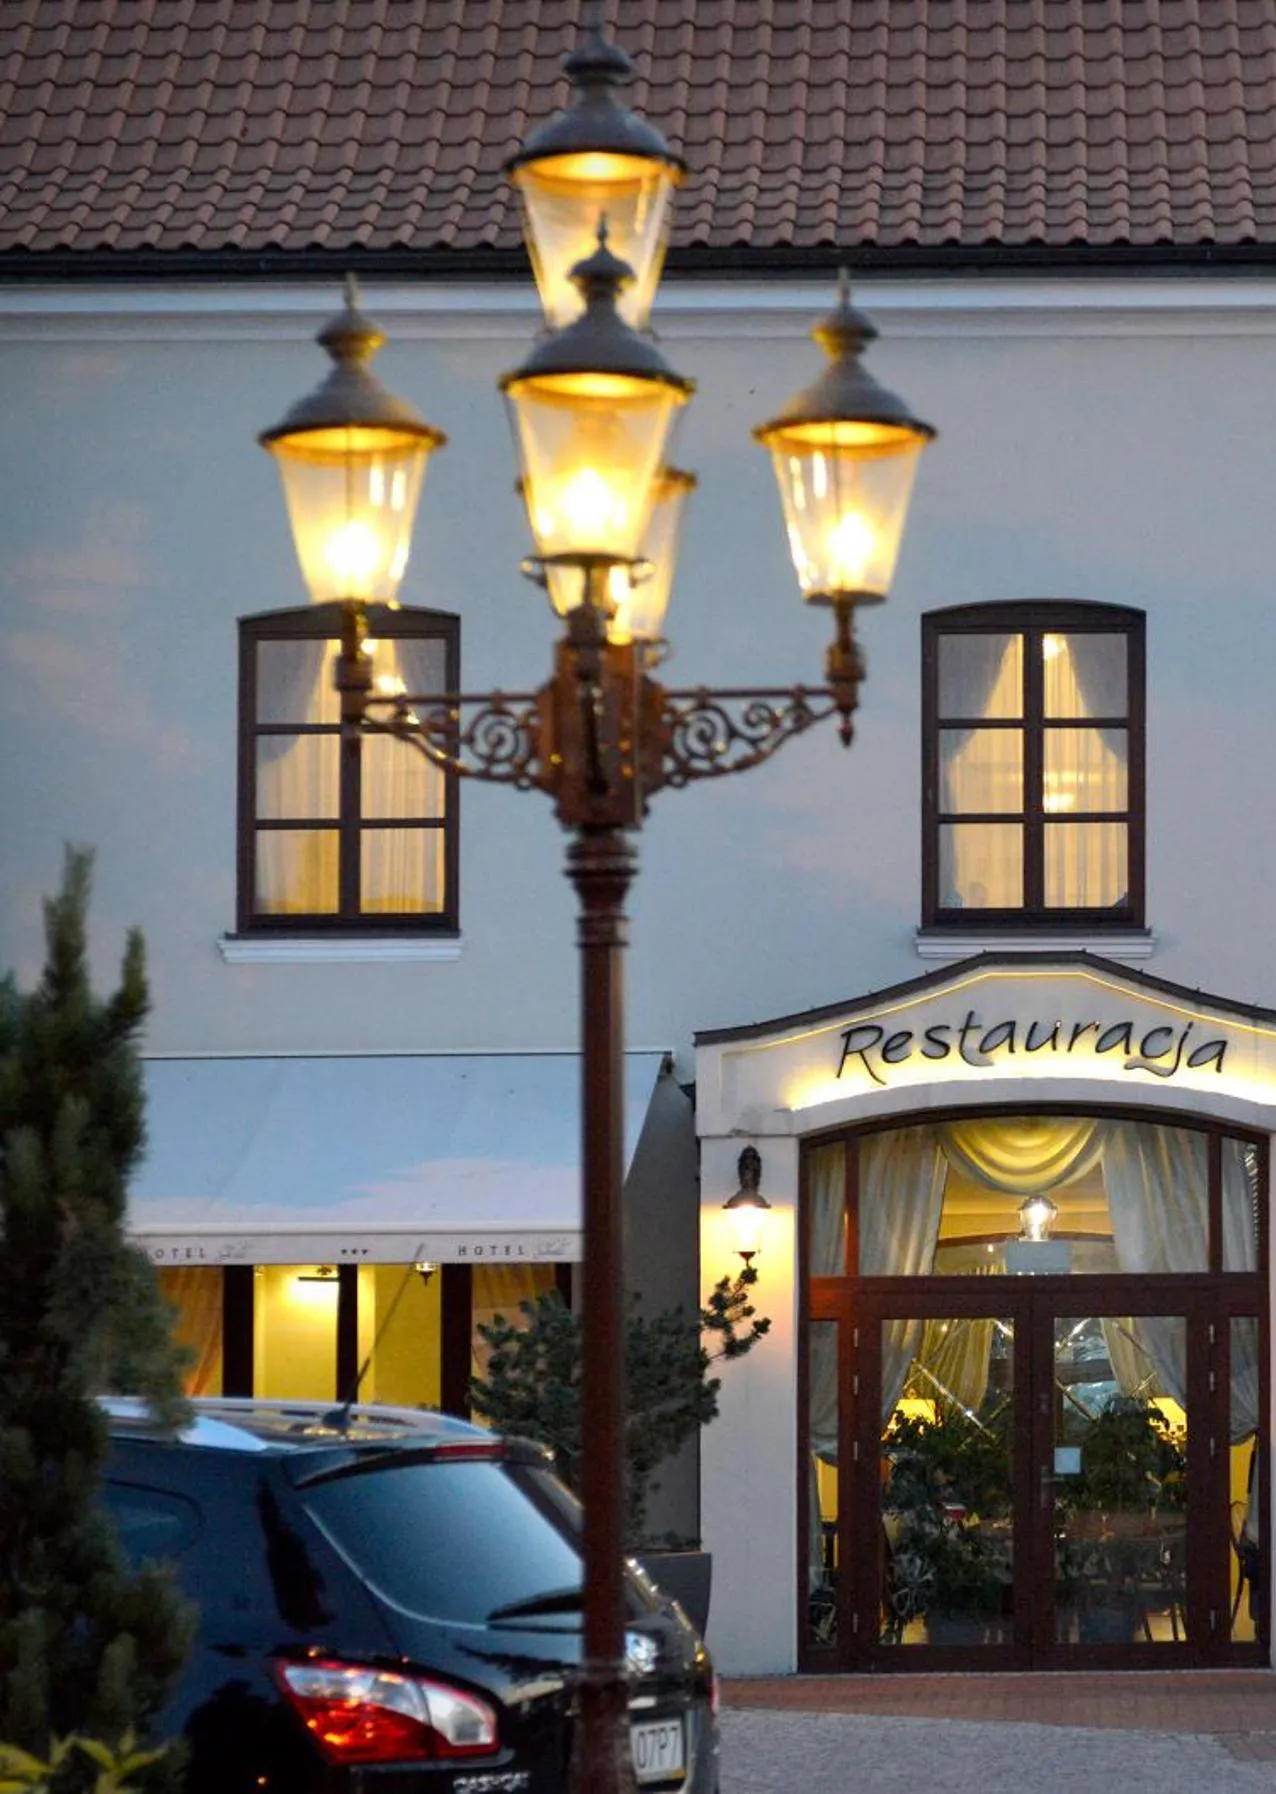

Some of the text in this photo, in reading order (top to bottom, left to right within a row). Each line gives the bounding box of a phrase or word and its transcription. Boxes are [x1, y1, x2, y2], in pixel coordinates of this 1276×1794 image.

[836, 1010, 1228, 1086] Restauracja
[140, 1248, 204, 1259] OTEL
[458, 1245, 524, 1256] HOTEL
